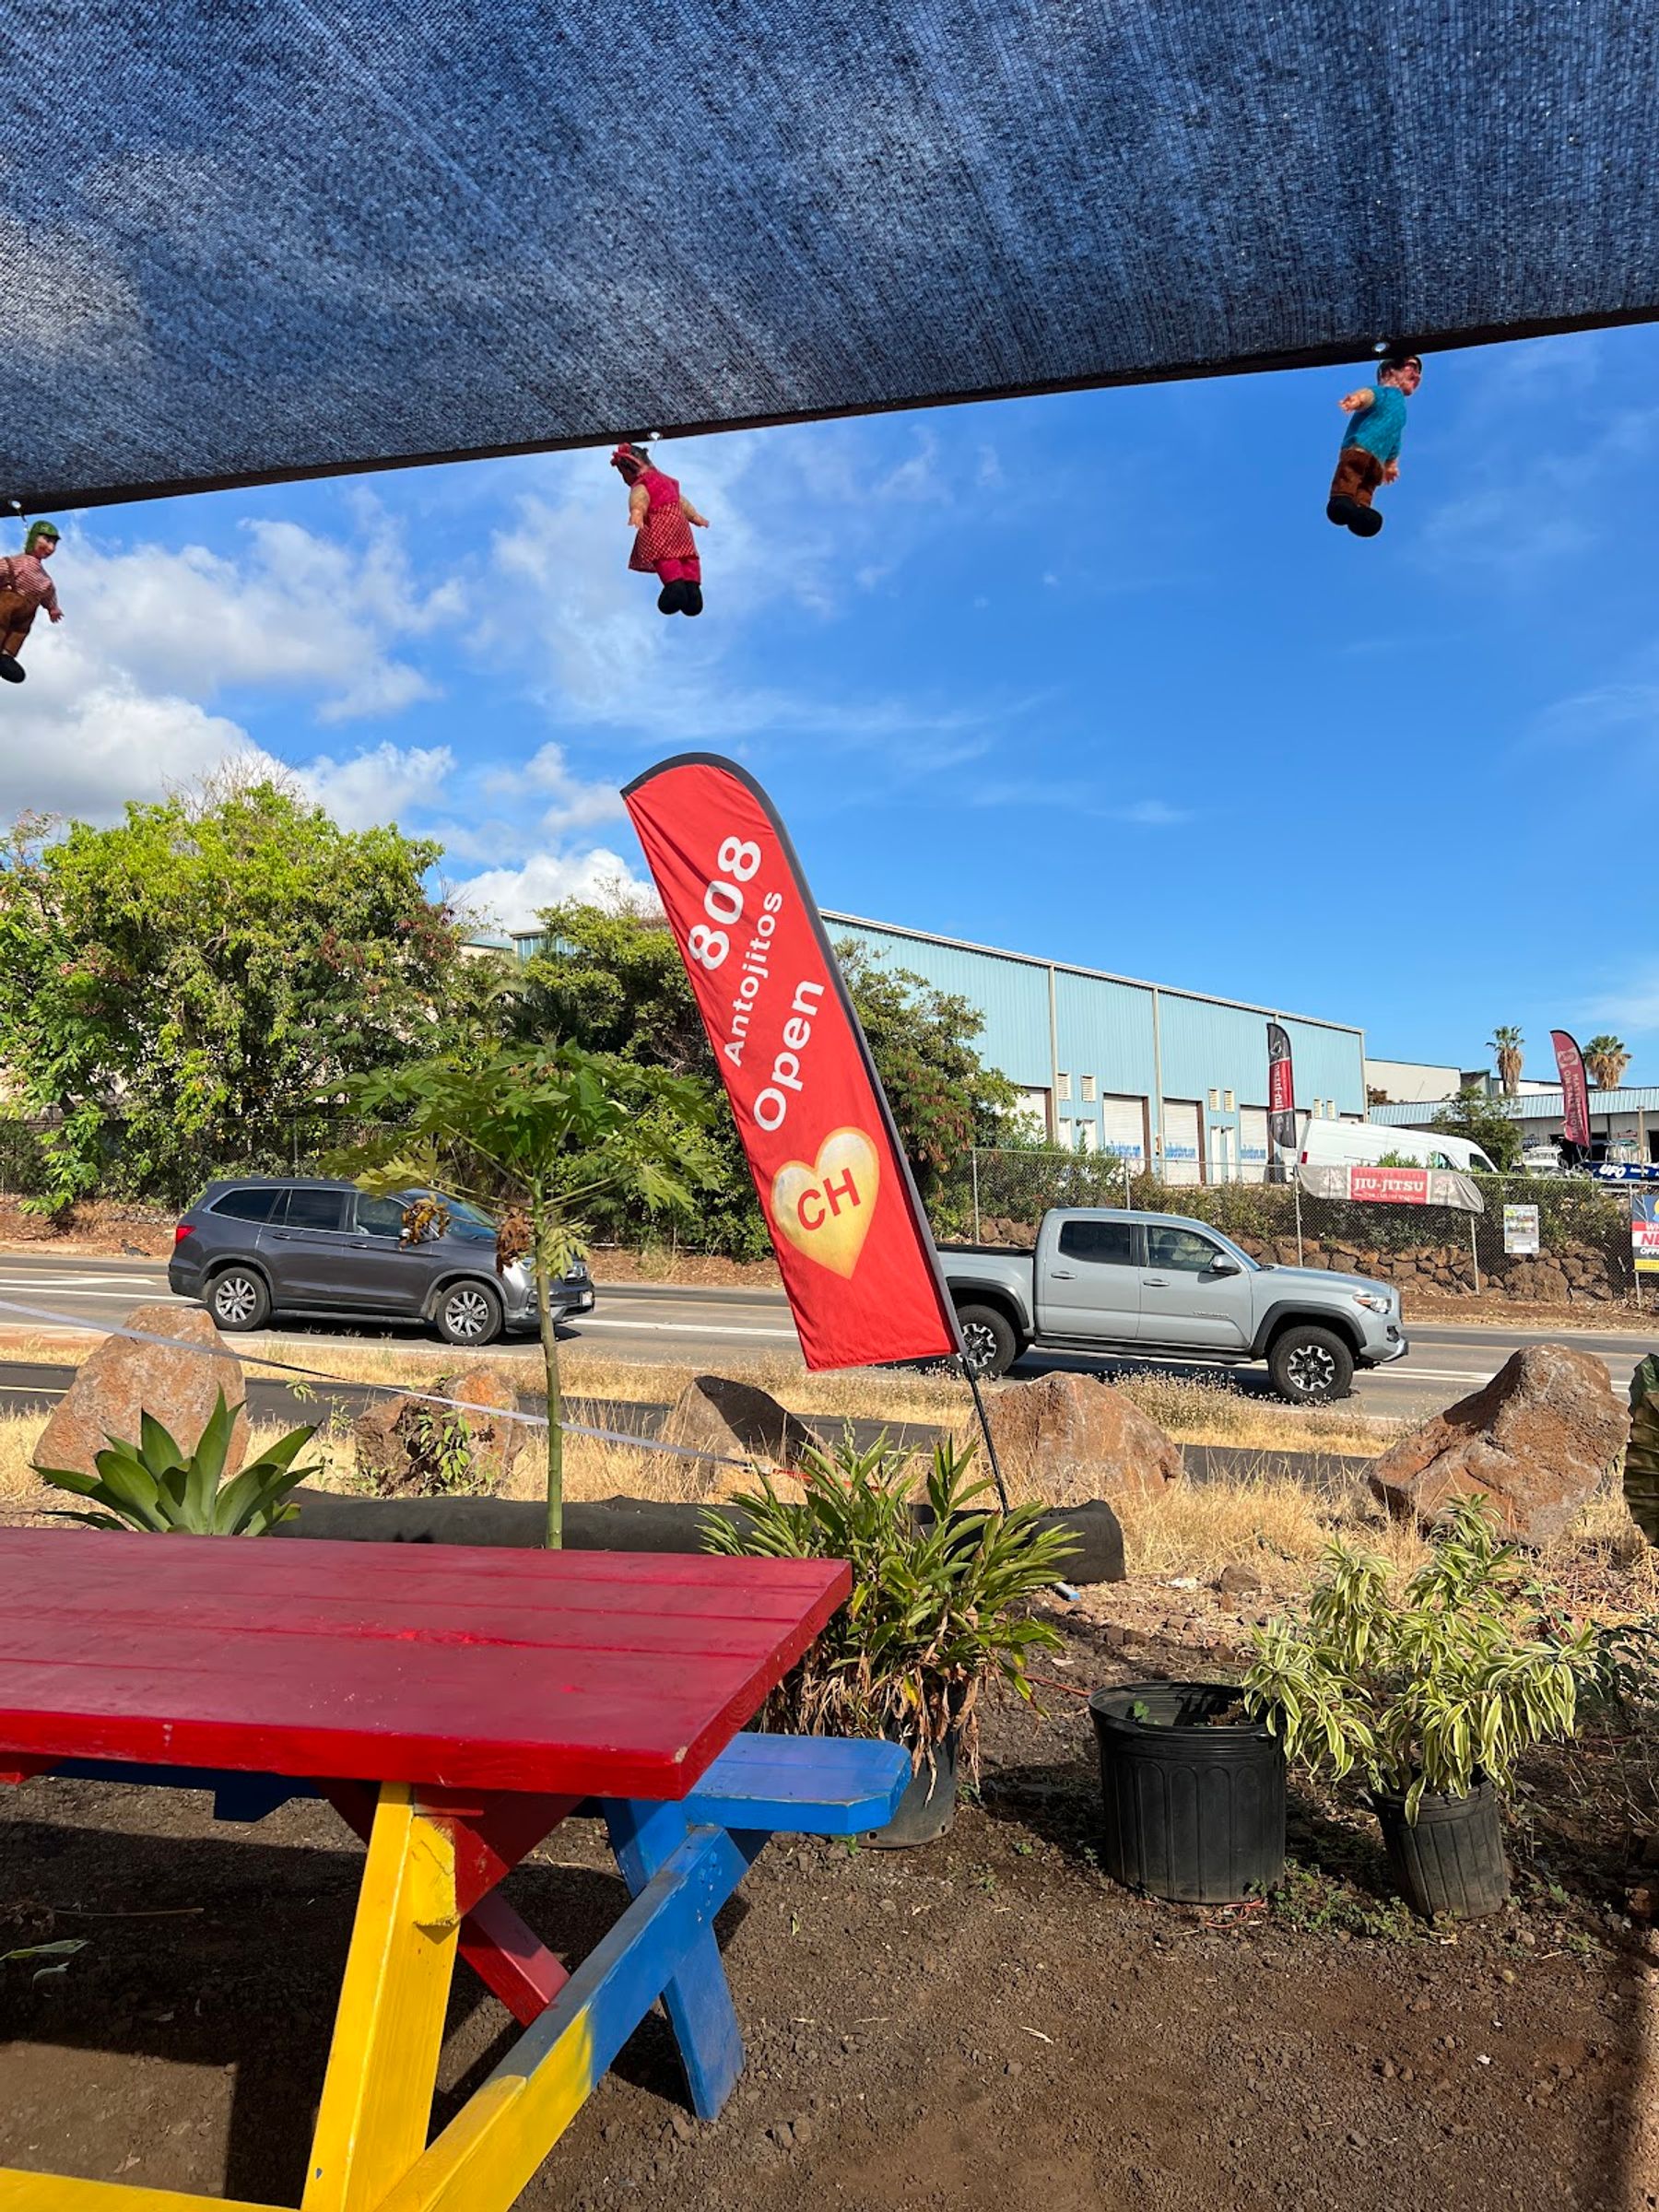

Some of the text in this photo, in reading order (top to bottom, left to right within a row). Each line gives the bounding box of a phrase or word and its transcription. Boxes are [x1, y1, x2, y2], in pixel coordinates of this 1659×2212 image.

[688, 835, 762, 971] 808
[724, 890, 783, 1068] Antojitos
[754, 981, 826, 1132] Open
[796, 1167, 863, 1232] CH
[1354, 1177, 1424, 1193] JIU-JITSU
[1599, 1164, 1627, 1178] UFO
